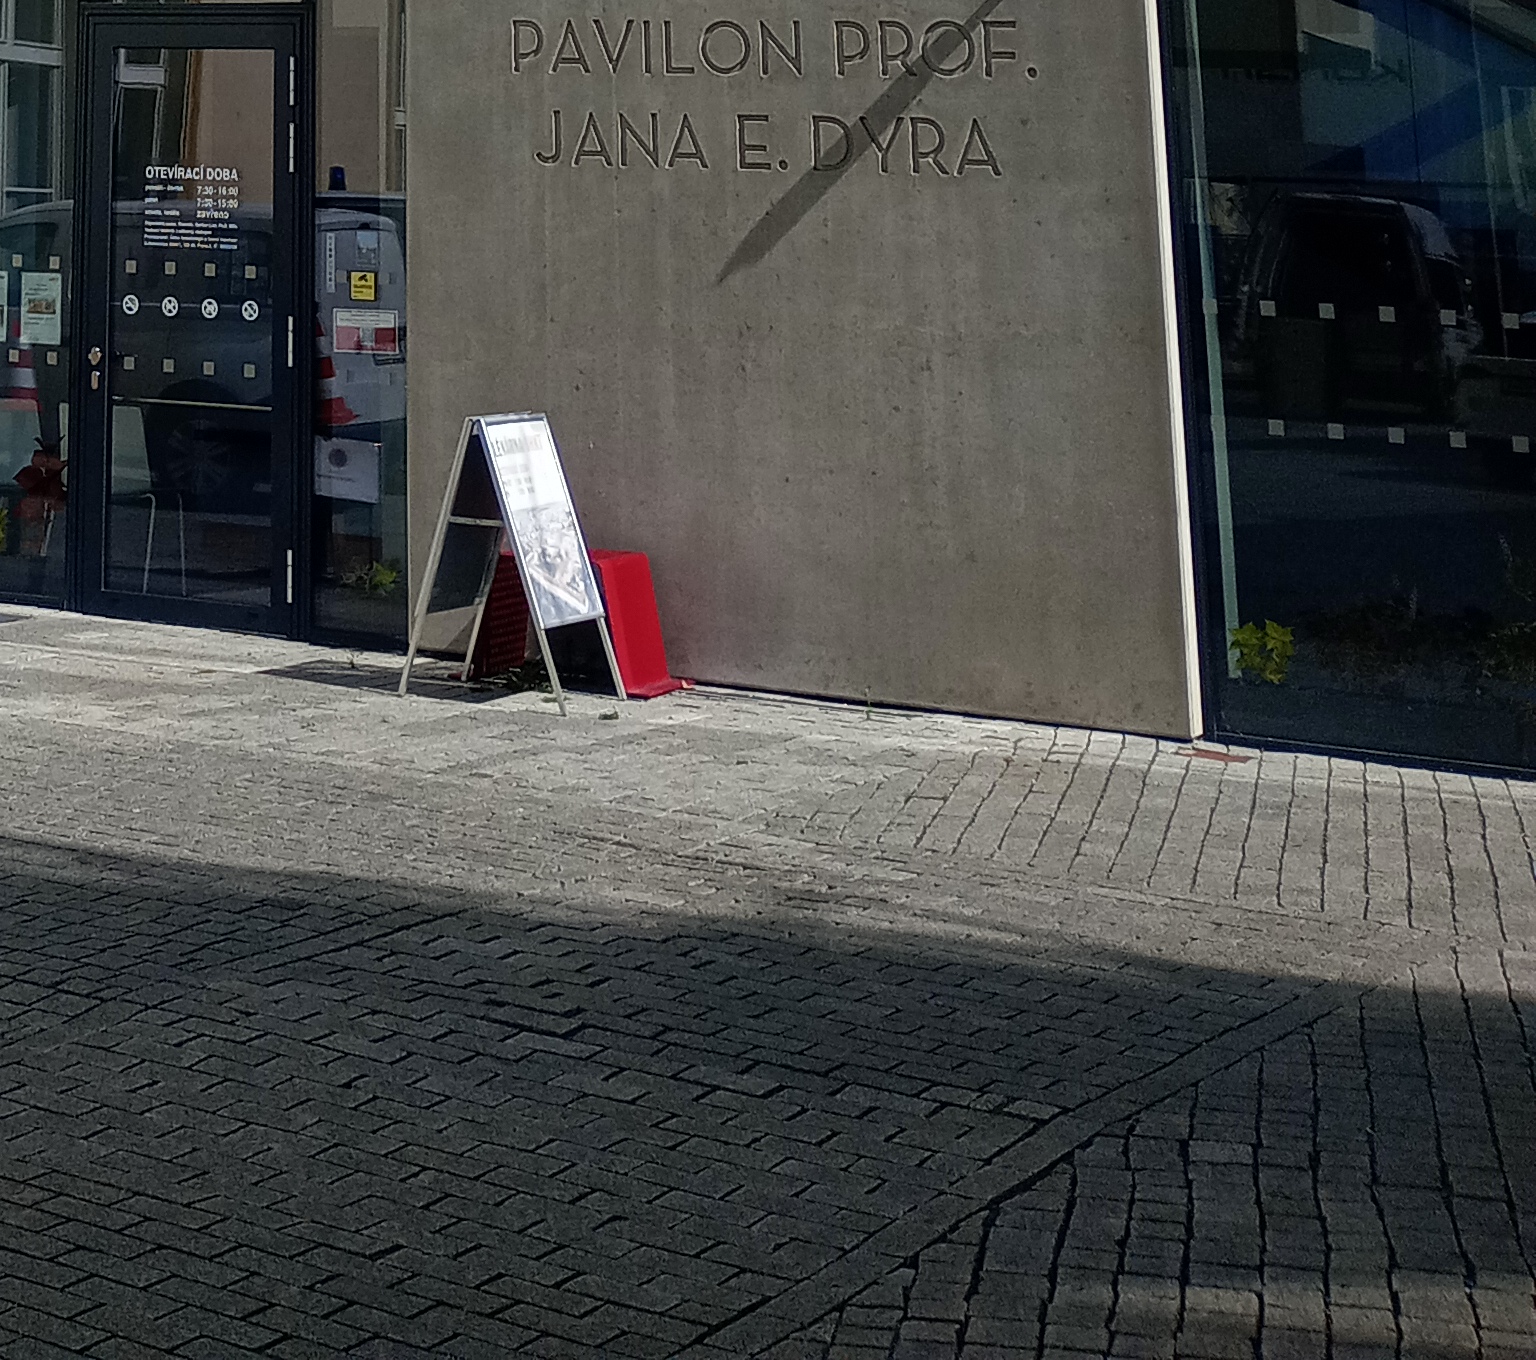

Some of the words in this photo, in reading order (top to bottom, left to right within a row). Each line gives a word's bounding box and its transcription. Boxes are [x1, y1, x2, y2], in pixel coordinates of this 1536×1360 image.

[511, 18, 803, 78] PAVILON
[833, 18, 1039, 79] PROF.
[145, 164, 205, 180] OTEVÍRACÍ
[206, 167, 239, 181] DOBA
[534, 108, 710, 171] JANA
[735, 113, 789, 172] E.
[811, 114, 1003, 178] DYRA
